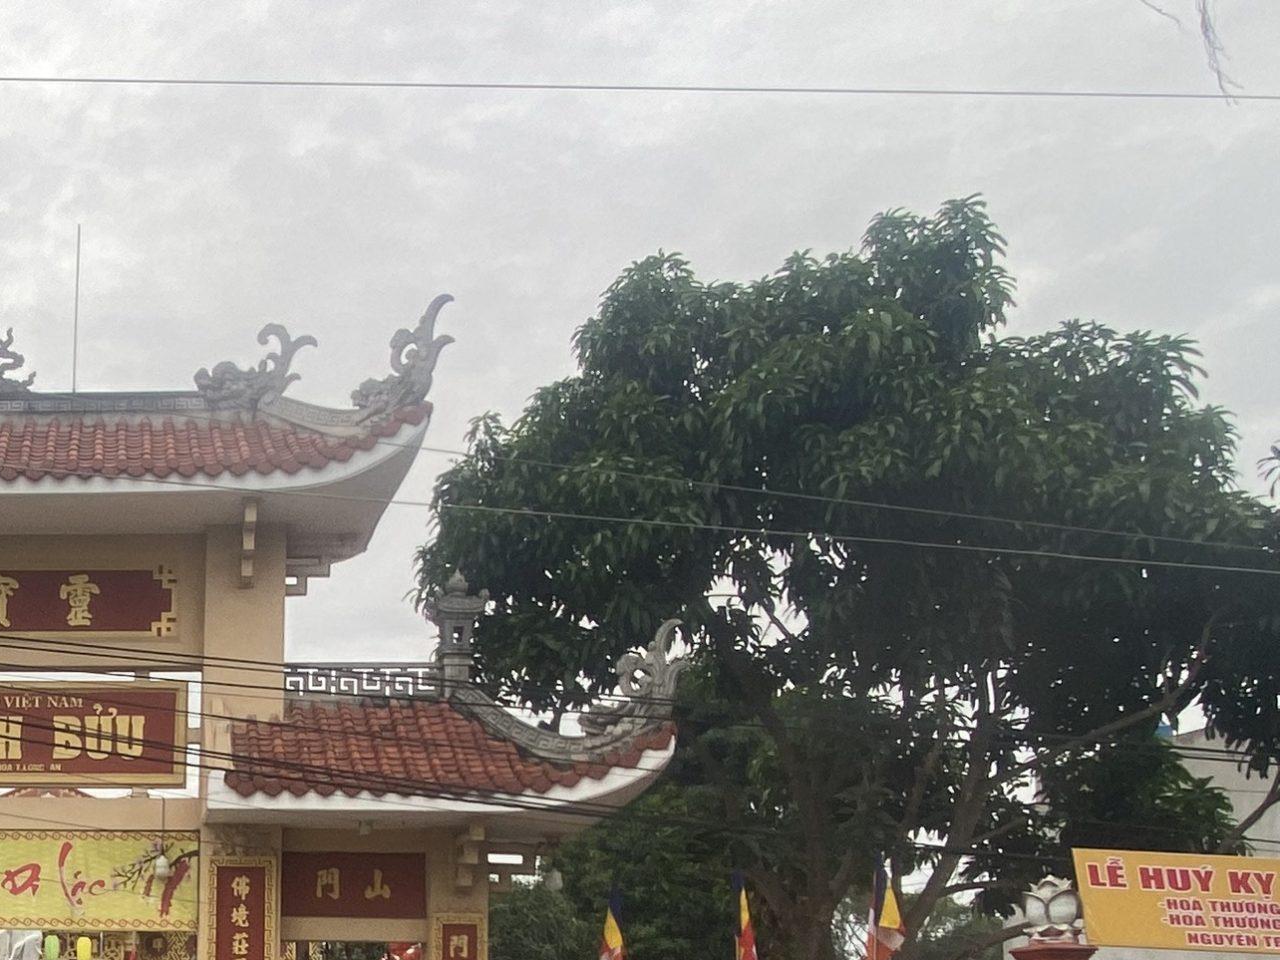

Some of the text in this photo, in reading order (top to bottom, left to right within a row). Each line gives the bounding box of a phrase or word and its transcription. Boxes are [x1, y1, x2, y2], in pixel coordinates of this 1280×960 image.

[3, 692, 43, 710] VIỆT
[47, 695, 84, 709] NAM
[52, 703, 146, 761] BỬU
[1086, 855, 1128, 889] LỄ
